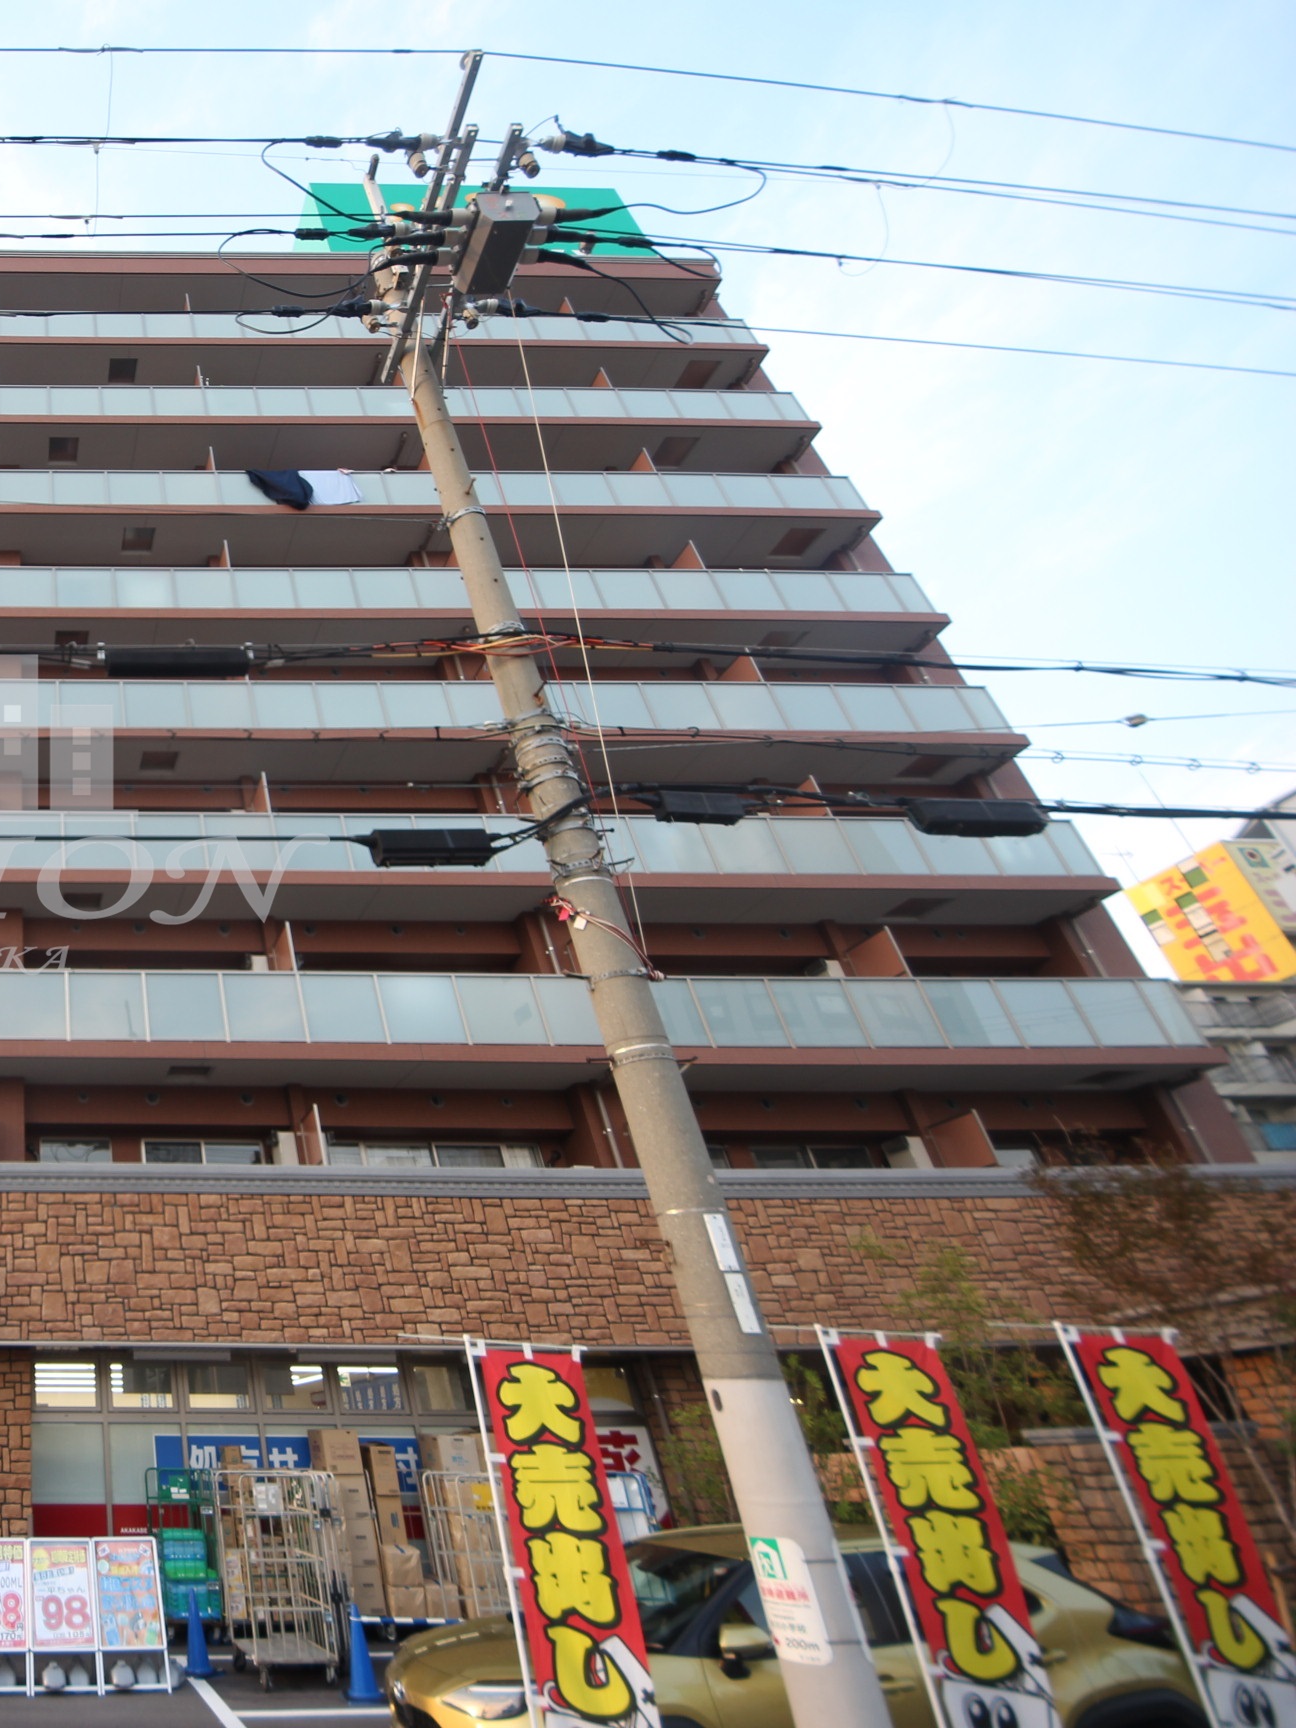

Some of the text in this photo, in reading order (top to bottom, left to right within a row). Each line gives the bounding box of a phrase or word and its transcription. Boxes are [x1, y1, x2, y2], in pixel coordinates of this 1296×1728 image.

[496, 1360, 634, 1719] 大売出し
[854, 1348, 1022, 1682] 大売出し
[1097, 1344, 1269, 1672] 大売出し
